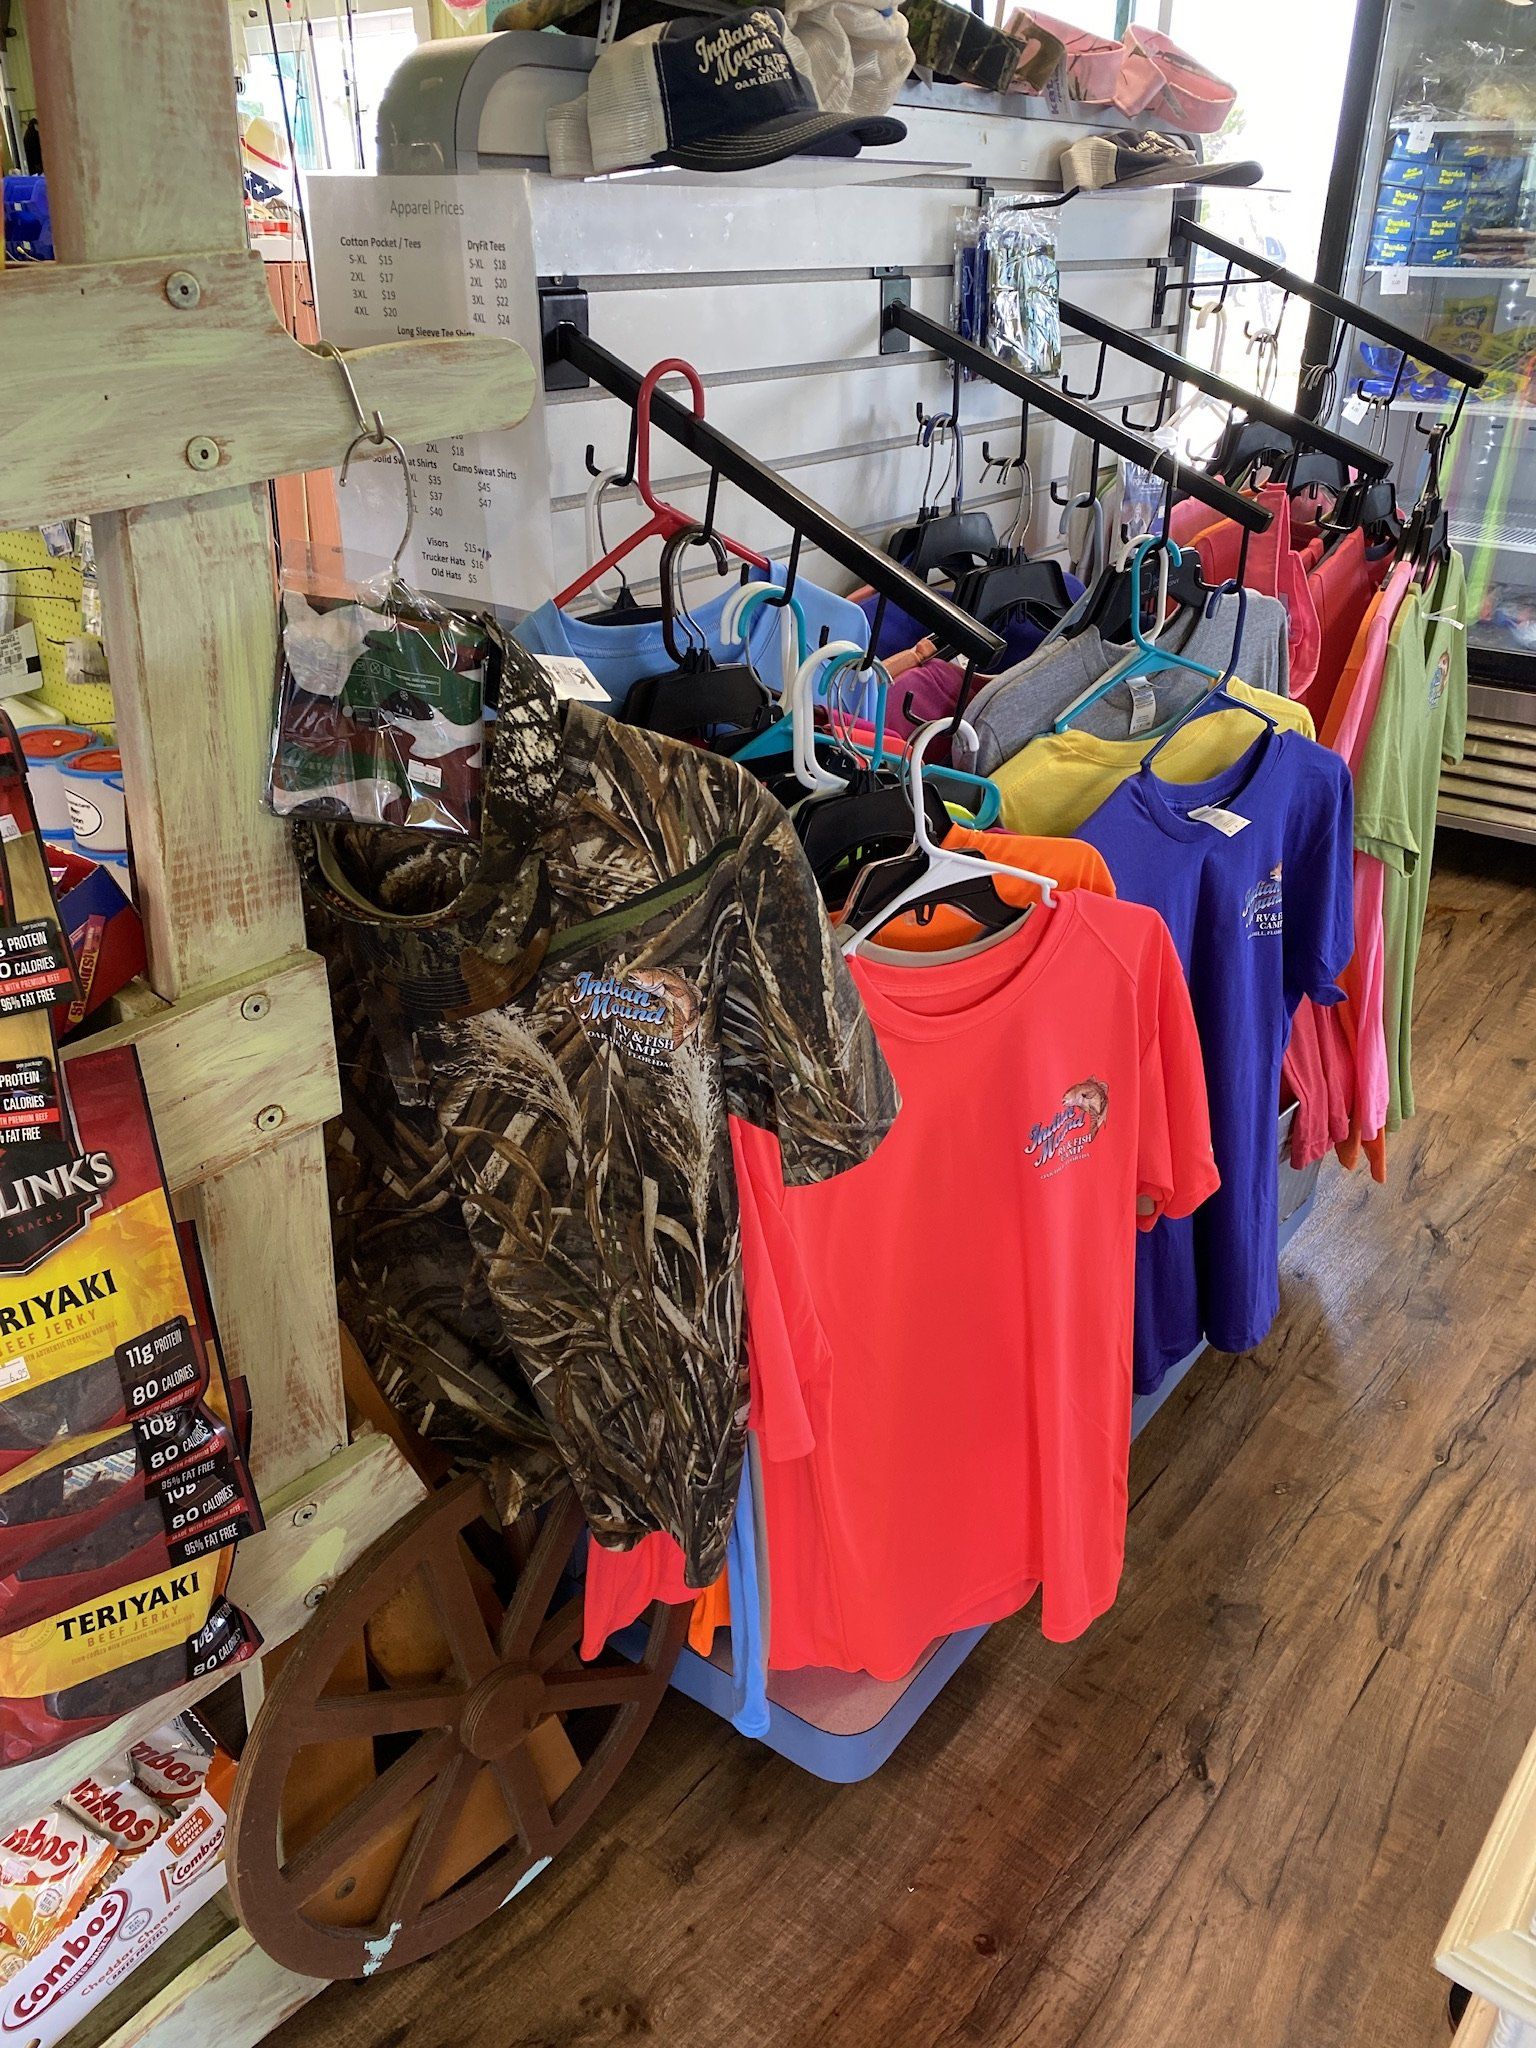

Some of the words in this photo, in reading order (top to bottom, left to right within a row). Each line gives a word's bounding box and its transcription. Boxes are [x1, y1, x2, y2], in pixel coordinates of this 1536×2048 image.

[695, 23, 758, 73] Indian
[715, 32, 774, 85] Mound
[758, 64, 786, 75] CAMP
[734, 77, 757, 90] OAK
[390, 200, 431, 217] Apparel
[434, 200, 464, 216] Prices
[340, 236, 369, 247] Cotton
[370, 237, 397, 248] Pocket
[398, 237, 403, 249] /
[404, 238, 422, 248] Tees
[467, 240, 489, 252] DryFit
[489, 240, 506, 251] Tees
[349, 254, 367, 264] S-XL
[379, 254, 393, 265] $15
[469, 258, 484, 269] S-XL
[493, 258, 507, 270] $18
[350, 271, 365, 282] 2XL
[380, 272, 394, 283] $17
[470, 276, 483, 287] 2XL
[495, 277, 507, 289] $20
[352, 288, 368, 299] 3XL
[381, 289, 396, 300] $19
[472, 295, 485, 305] 3XL
[496, 295, 509, 307] $22
[354, 306, 369, 316] 4XL
[383, 306, 398, 317] $20
[473, 312, 486, 324] 4XL
[497, 313, 510, 325] $24
[397, 326, 414, 337] Long
[416, 326, 440, 337] Sleeve
[426, 443, 439, 454] 2XL
[451, 445, 464, 457] $18
[417, 459, 438, 469] Shirts
[452, 462, 473, 473] Camo
[474, 465, 496, 477] Sweat
[497, 468, 517, 480] Shirts
[428, 474, 442, 486] $35
[477, 482, 491, 493] $45
[429, 490, 443, 501] $37
[478, 498, 492, 509] $47
[429, 506, 443, 517] $40
[426, 537, 449, 548] Visors
[464, 542, 477, 553] $15
[421, 551, 448, 563] Trucker
[450, 556, 466, 566] Hats
[471, 559, 484, 570] $16
[431, 567, 444, 577] Old
[446, 570, 462, 581] Hats
[468, 573, 478, 584] $5
[1256, 913, 1271, 922] RV
[7, 931, 48, 951] PROTEIN
[14, 956, 56, 975] CALORIES
[4, 983, 20, 993] WITH
[20, 976, 47, 989] PREMIUM
[47, 972, 60, 983] BEEF
[569, 972, 651, 1007] Indian
[20, 992, 36, 1007] FAT
[36, 988, 56, 1004] FREE
[580, 995, 667, 1025] Mound
[615, 1019, 631, 1037] RV
[632, 1031, 644, 1043] &
[646, 1034, 675, 1050] FISH
[587, 1030, 608, 1040] OAK
[628, 1050, 669, 1068] FLORIDA
[619, 1034, 660, 1056] CAMP
[0, 1071, 40, 1088] PROTEIN
[3, 1096, 45, 1111] CALORIES
[8, 1113, 35, 1125] PREMIUM
[35, 1112, 48, 1122] BEEF
[6, 1129, 20, 1143] FAT
[22, 1127, 41, 1141] FREE
[1024, 1106, 1076, 1154] Indian
[1073, 1133, 1092, 1146] FISH
[1060, 1145, 1084, 1162] CAMP
[0, 1152, 114, 1220] LINK'S
[7, 1211, 63, 1238] SNACKS
[0, 1269, 118, 1336] RIYAKI
[45, 1309, 97, 1339] JERKY
[125, 1343, 154, 1368] 11g
[153, 1329, 183, 1355] PROTEIN
[132, 1380, 159, 1406] 80
[161, 1363, 195, 1392] CALORIES
[160, 1392, 184, 1411] PREMIUM
[183, 1385, 196, 1399] BEEF
[140, 1414, 176, 1440] 10g
[150, 1444, 179, 1469] 80
[183, 1447, 211, 1466] PREMIUM
[210, 1440, 220, 1453] BEEF
[161, 1473, 181, 1491] 95%
[181, 1467, 196, 1483] FAT
[197, 1459, 216, 1477] FREE
[172, 1507, 199, 1529] 80
[188, 1521, 203, 1534] WITH
[203, 1511, 229, 1527] PREMIUM
[228, 1503, 241, 1516] BEEF
[184, 1539, 205, 1556] 95%
[204, 1531, 219, 1548] FAT
[219, 1522, 239, 1542] FREE
[56, 1571, 200, 1641] TERIYAKI
[87, 1626, 125, 1648] BEEF
[133, 1605, 179, 1631] JERKY
[193, 1654, 217, 1676] 80
[174, 1814, 197, 1841] SINGLE
[175, 1818, 204, 1847] SERVING
[182, 1825, 204, 1848] PACKS
[176, 1829, 223, 1880] Combos
[13, 1898, 118, 2018] Combos
[81, 1946, 135, 1996] Cheddar
[137, 1902, 182, 1944] Cheese
[111, 1955, 135, 1980] BAKED
[135, 1928, 165, 1958] PRETZEL
[59, 1965, 89, 1995] STUFFED
[86, 1936, 111, 1966] SNACKS
